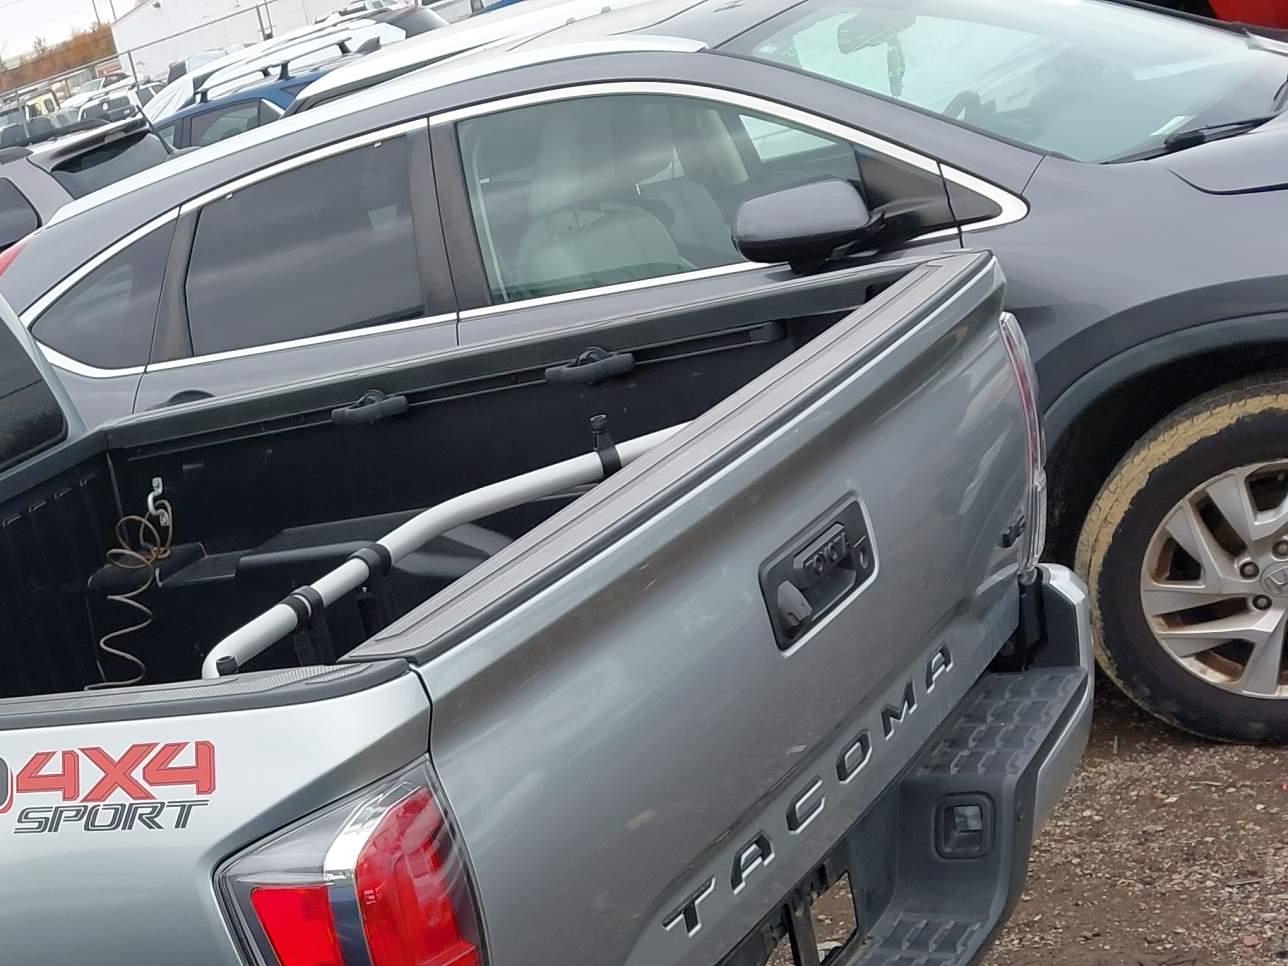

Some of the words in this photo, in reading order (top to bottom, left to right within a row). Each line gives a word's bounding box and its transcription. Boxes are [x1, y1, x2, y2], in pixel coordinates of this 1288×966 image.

[15, 740, 217, 803] 4X4
[662, 645, 954, 938] TACOMA
[13, 799, 211, 834] SPORT
